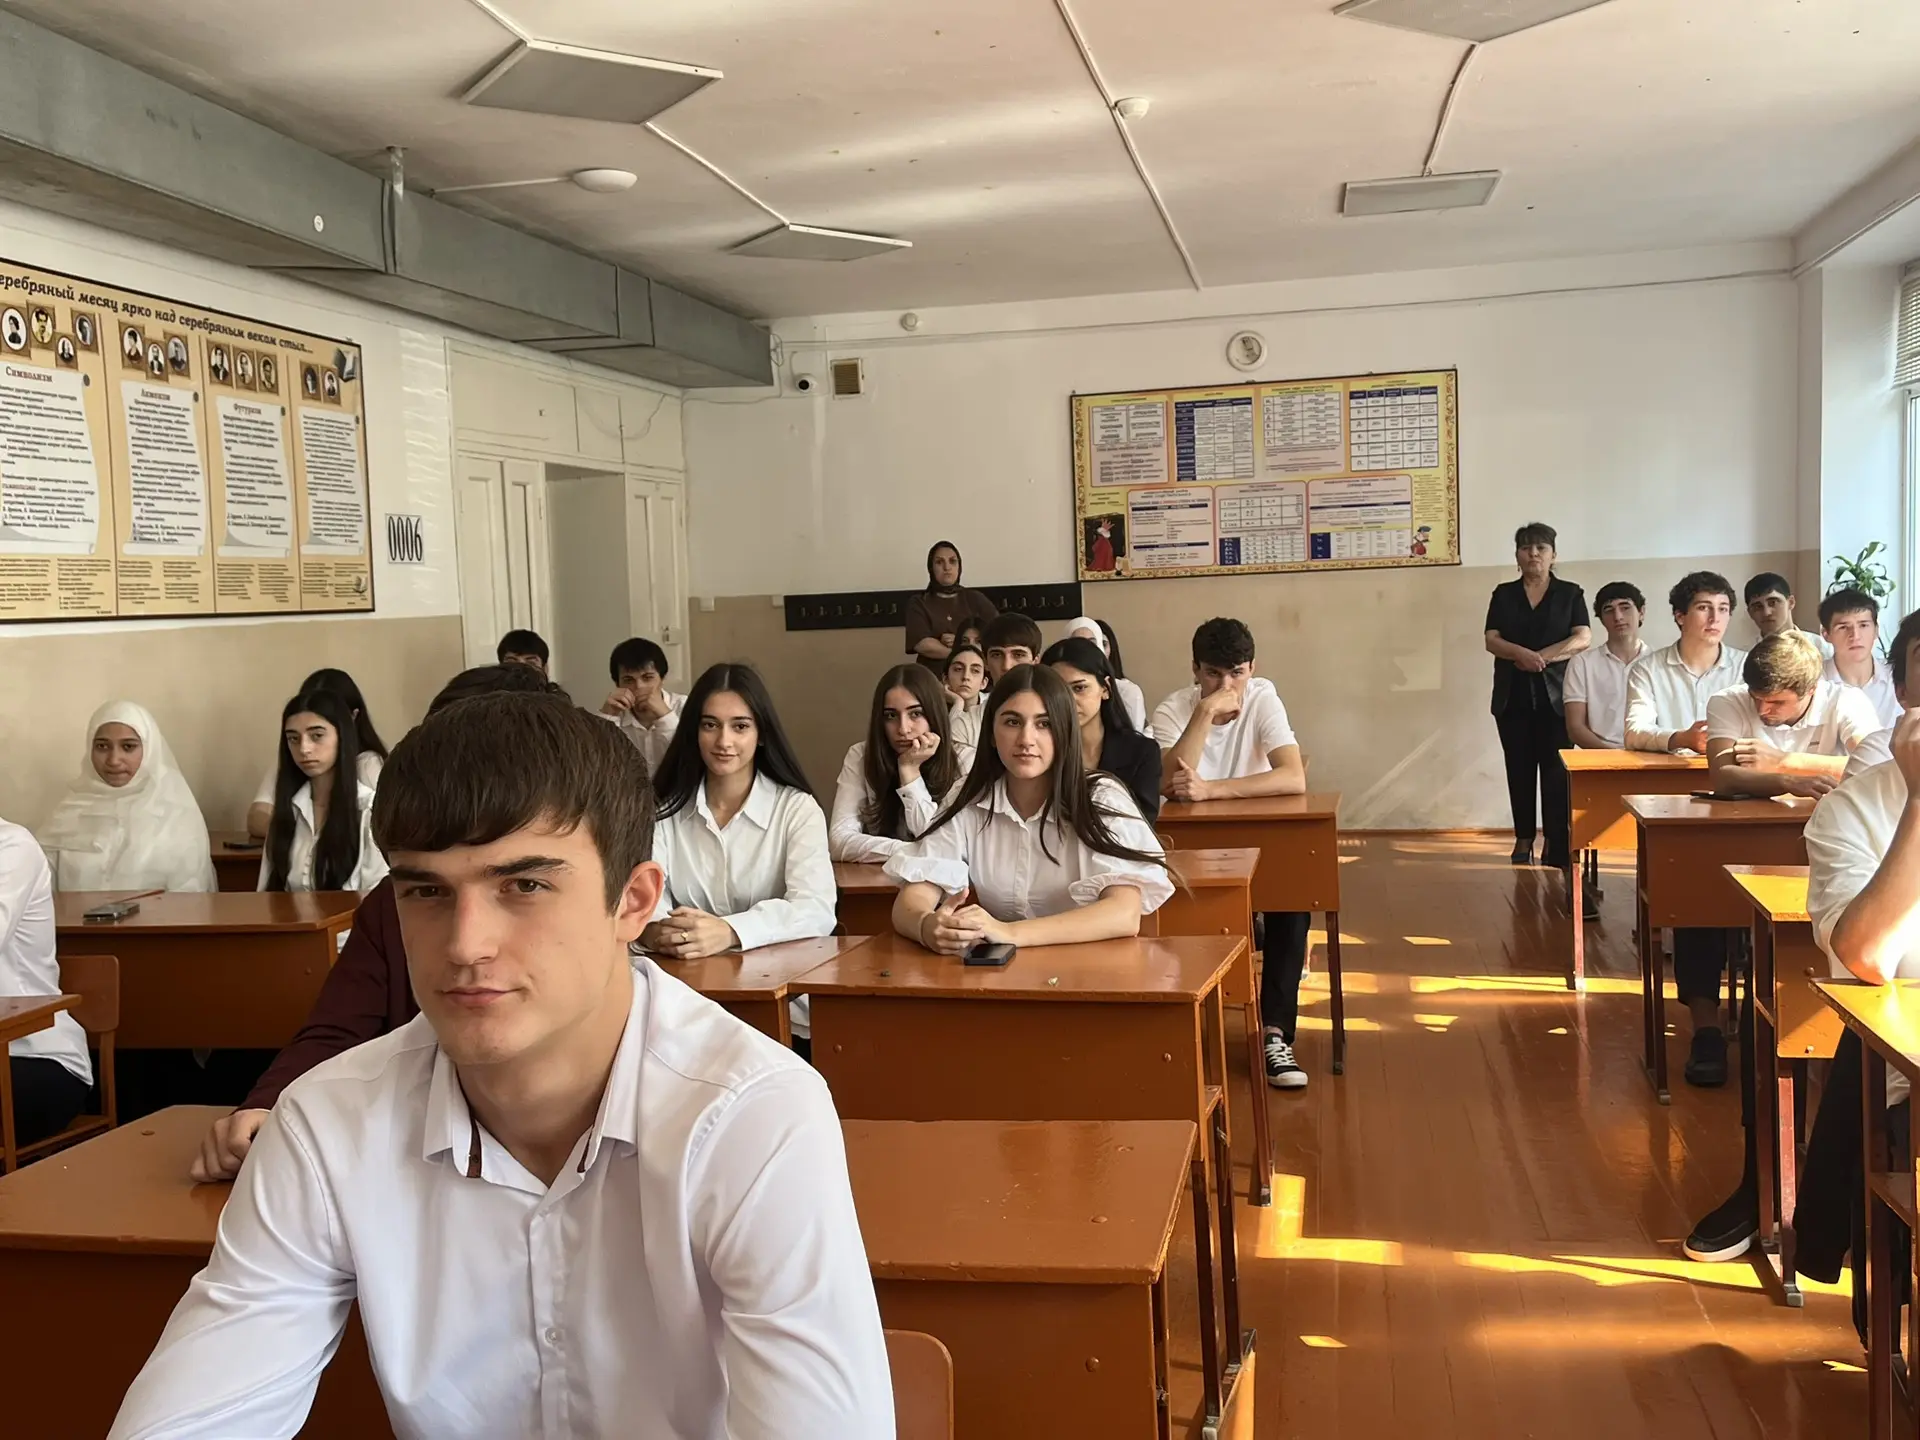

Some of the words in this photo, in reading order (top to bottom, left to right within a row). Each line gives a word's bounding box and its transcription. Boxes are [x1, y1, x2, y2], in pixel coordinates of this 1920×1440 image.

[78, 292, 118, 313] месяц
[121, 302, 151, 318] ярко
[155, 308, 176, 323] над
[179, 314, 245, 340] серебряным
[387, 515, 424, 562] 0006
